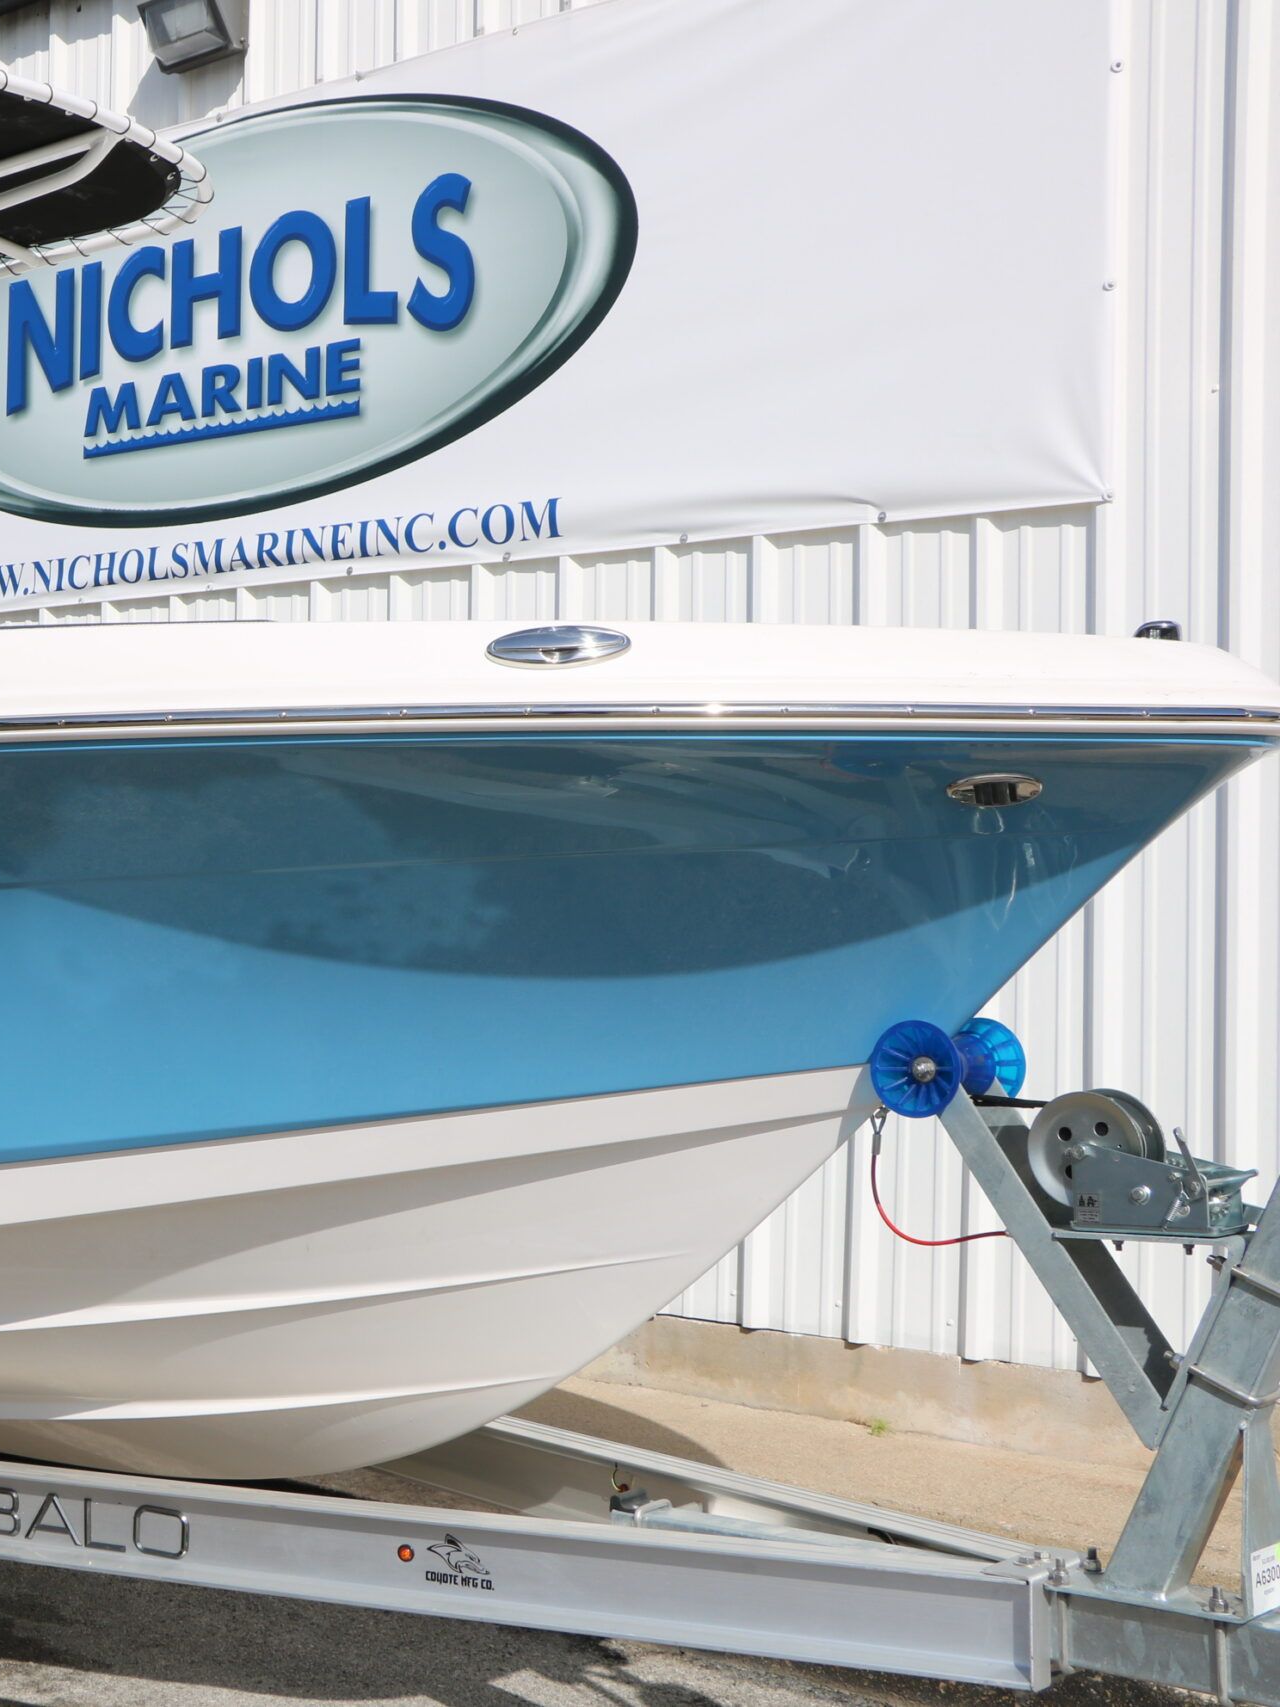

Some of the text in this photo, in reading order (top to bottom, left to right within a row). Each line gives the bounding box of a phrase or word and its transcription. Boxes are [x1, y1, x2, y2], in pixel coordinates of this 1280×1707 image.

[6, 172, 476, 417] NICHOLS
[83, 337, 361, 438] MARINE
[425, 1570, 495, 1591] COYOTE MFG CO.
